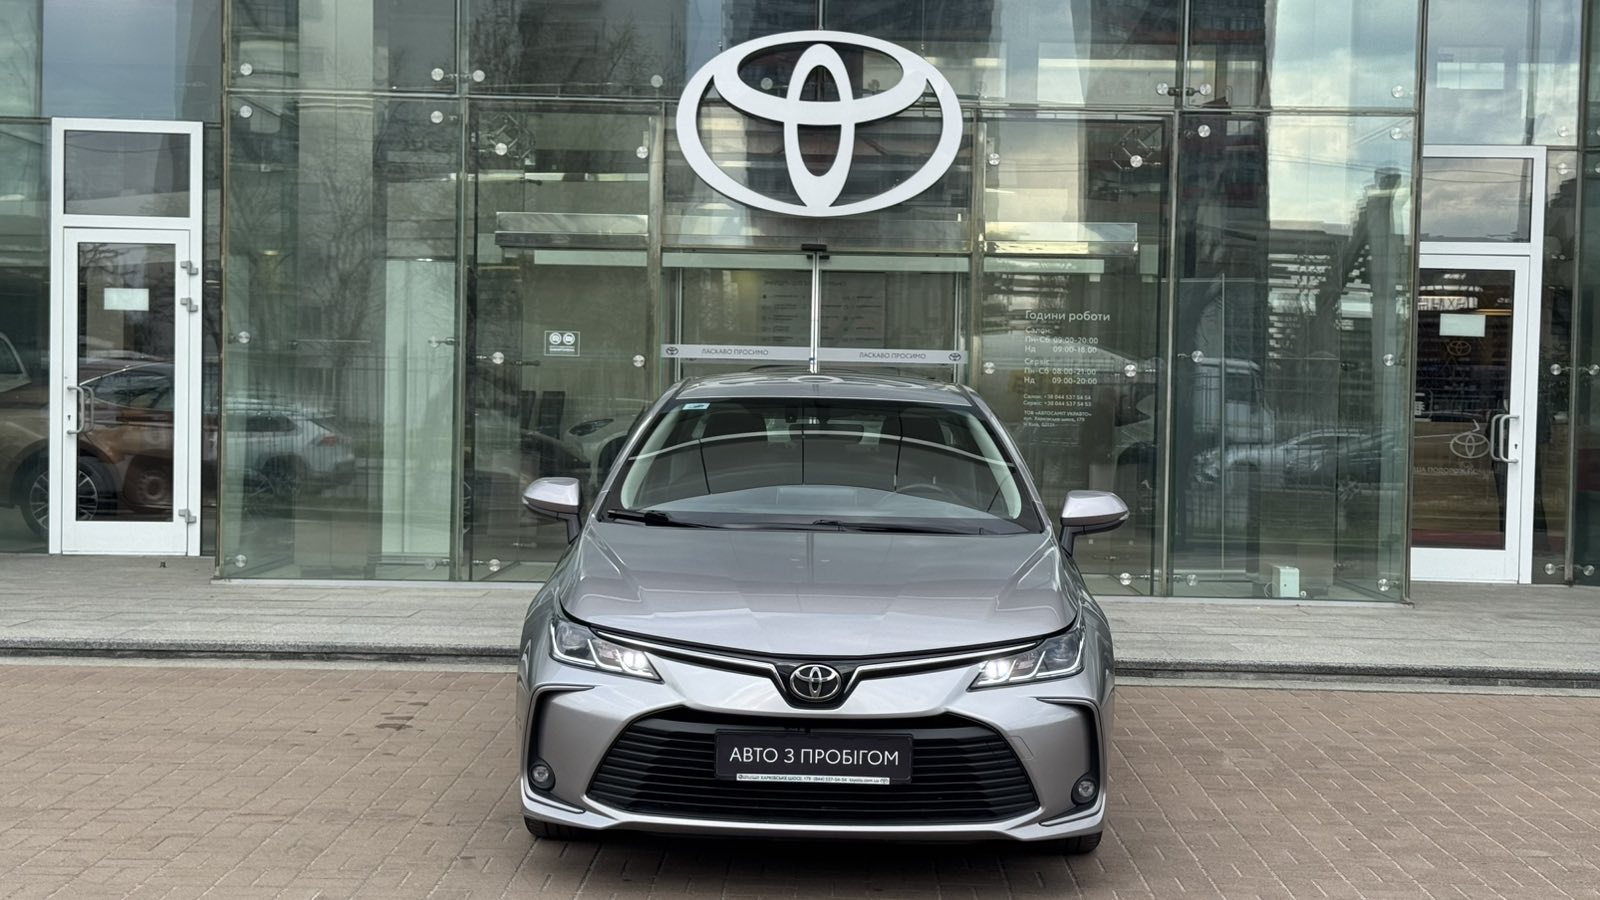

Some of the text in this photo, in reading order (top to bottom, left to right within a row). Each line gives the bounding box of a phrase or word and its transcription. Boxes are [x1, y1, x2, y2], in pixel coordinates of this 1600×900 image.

[1025, 310, 1111, 323] Години роботи
[701, 347, 769, 356] ЛАСКАВО ПРОСИМО
[1024, 345, 1037, 354] Нд
[859, 351, 927, 360] ЛАСКАВО ПРОСИМО
[1023, 376, 1036, 385] Нд
[729, 747, 899, 766] АВТО З ПРОБІГОМ
